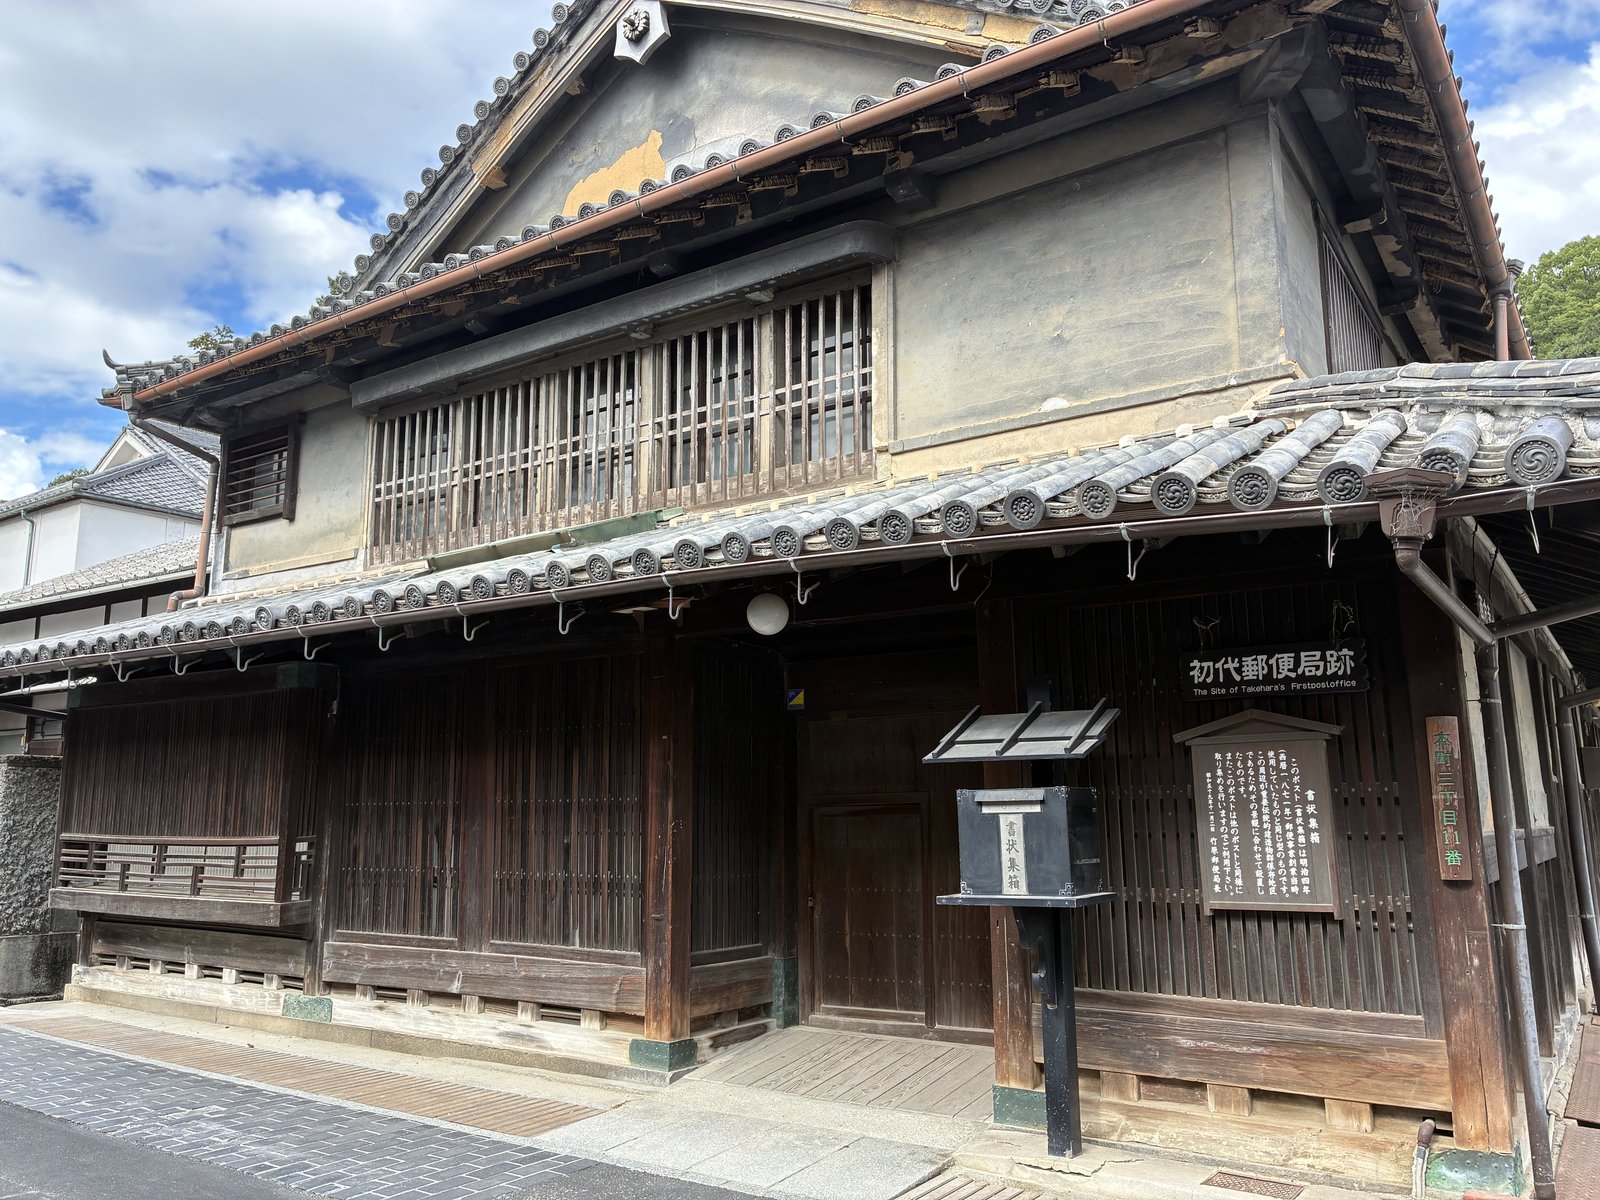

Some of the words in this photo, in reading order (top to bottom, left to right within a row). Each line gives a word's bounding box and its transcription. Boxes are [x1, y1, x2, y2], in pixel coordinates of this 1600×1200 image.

[1189, 648, 1355, 684] 初代郵便局跡
[1193, 688, 1208, 696] The
[1211, 687, 1226, 695] Site
[1229, 686, 1239, 694] of
[1241, 683, 1285, 693] Takehara's
[1235, 752, 1247, 798] たものです。
[1433, 731, 1462, 866] 本町三丁目11番
[1305, 790, 1320, 844] 書状集箱
[1005, 820, 1020, 890] 書状集箱
